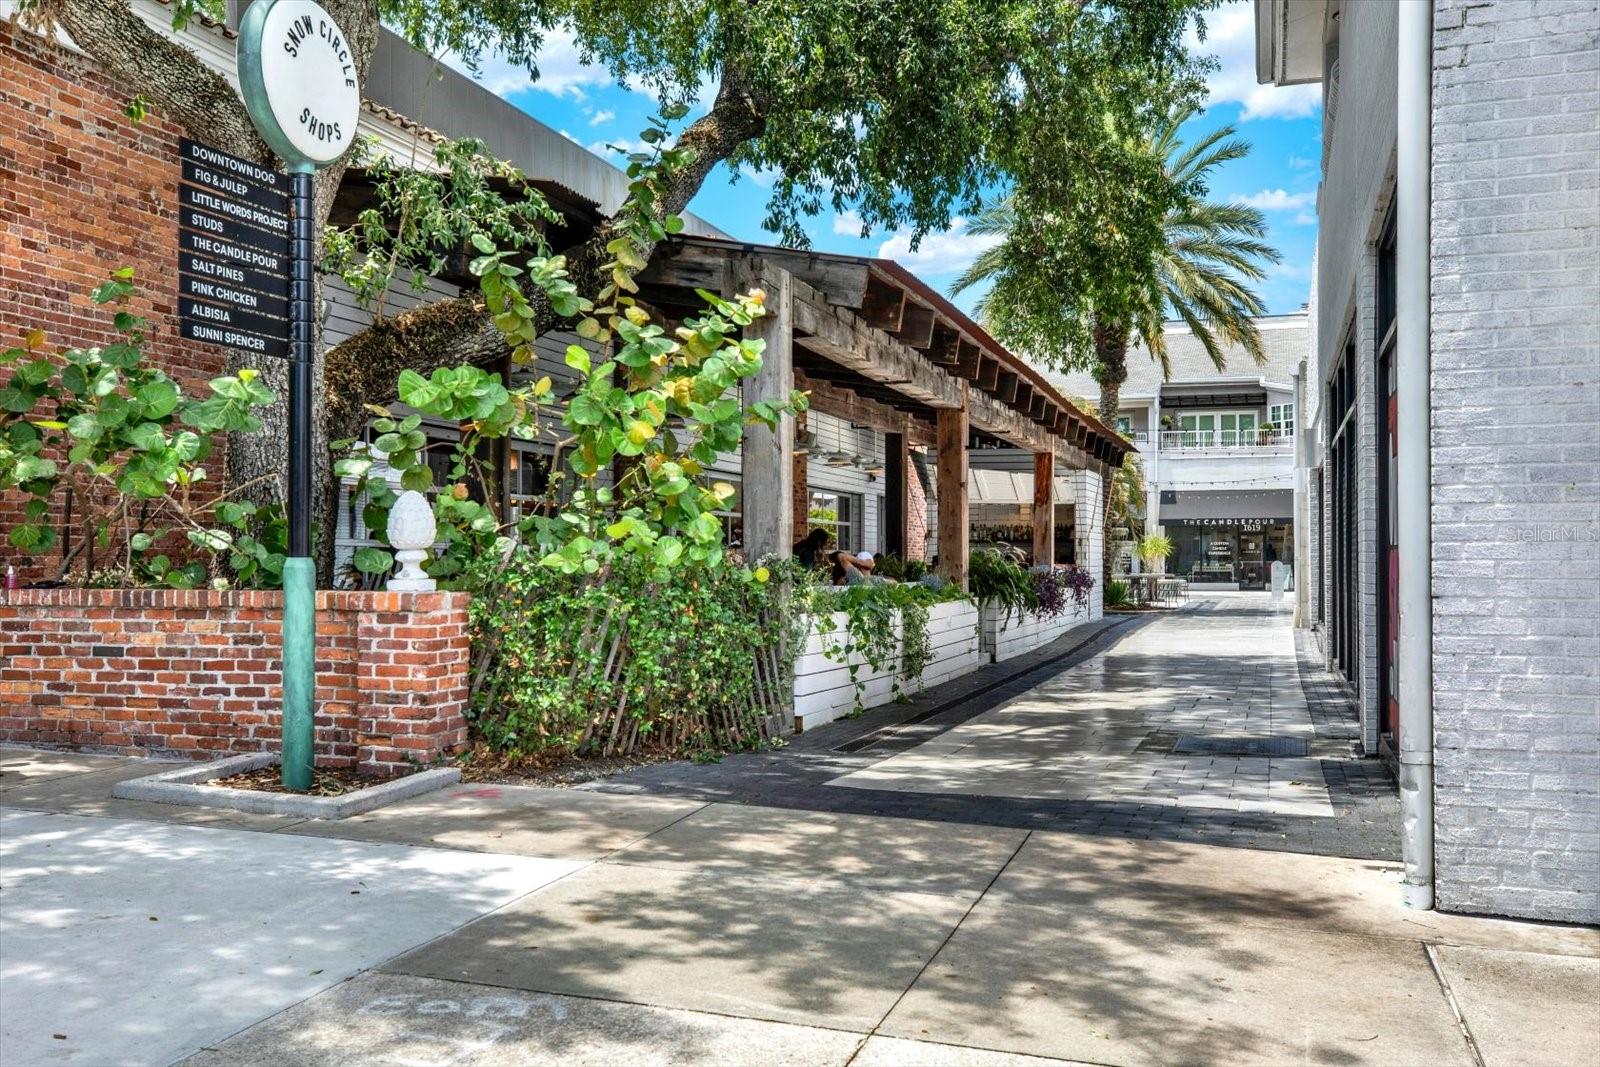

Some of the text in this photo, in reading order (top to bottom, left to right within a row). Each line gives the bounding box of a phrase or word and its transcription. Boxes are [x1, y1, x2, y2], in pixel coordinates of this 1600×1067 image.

[284, 15, 355, 88] SNOW CIRCLE
[300, 107, 342, 143] SHOPS
[192, 145, 276, 184] DOWNTOWN DOG
[195, 168, 248, 195] FIG & JULEP
[192, 191, 288, 231] LITTLE WORDS PROJECT
[192, 214, 223, 232] STUDS
[192, 236, 278, 269] THE CANDLE POUR
[192, 259, 244, 281] SALT PINES
[191, 281, 257, 307] PINK CHICKEN
[192, 304, 230, 322] ALBISIA
[193, 325, 265, 350] SUNNI SPENCER
